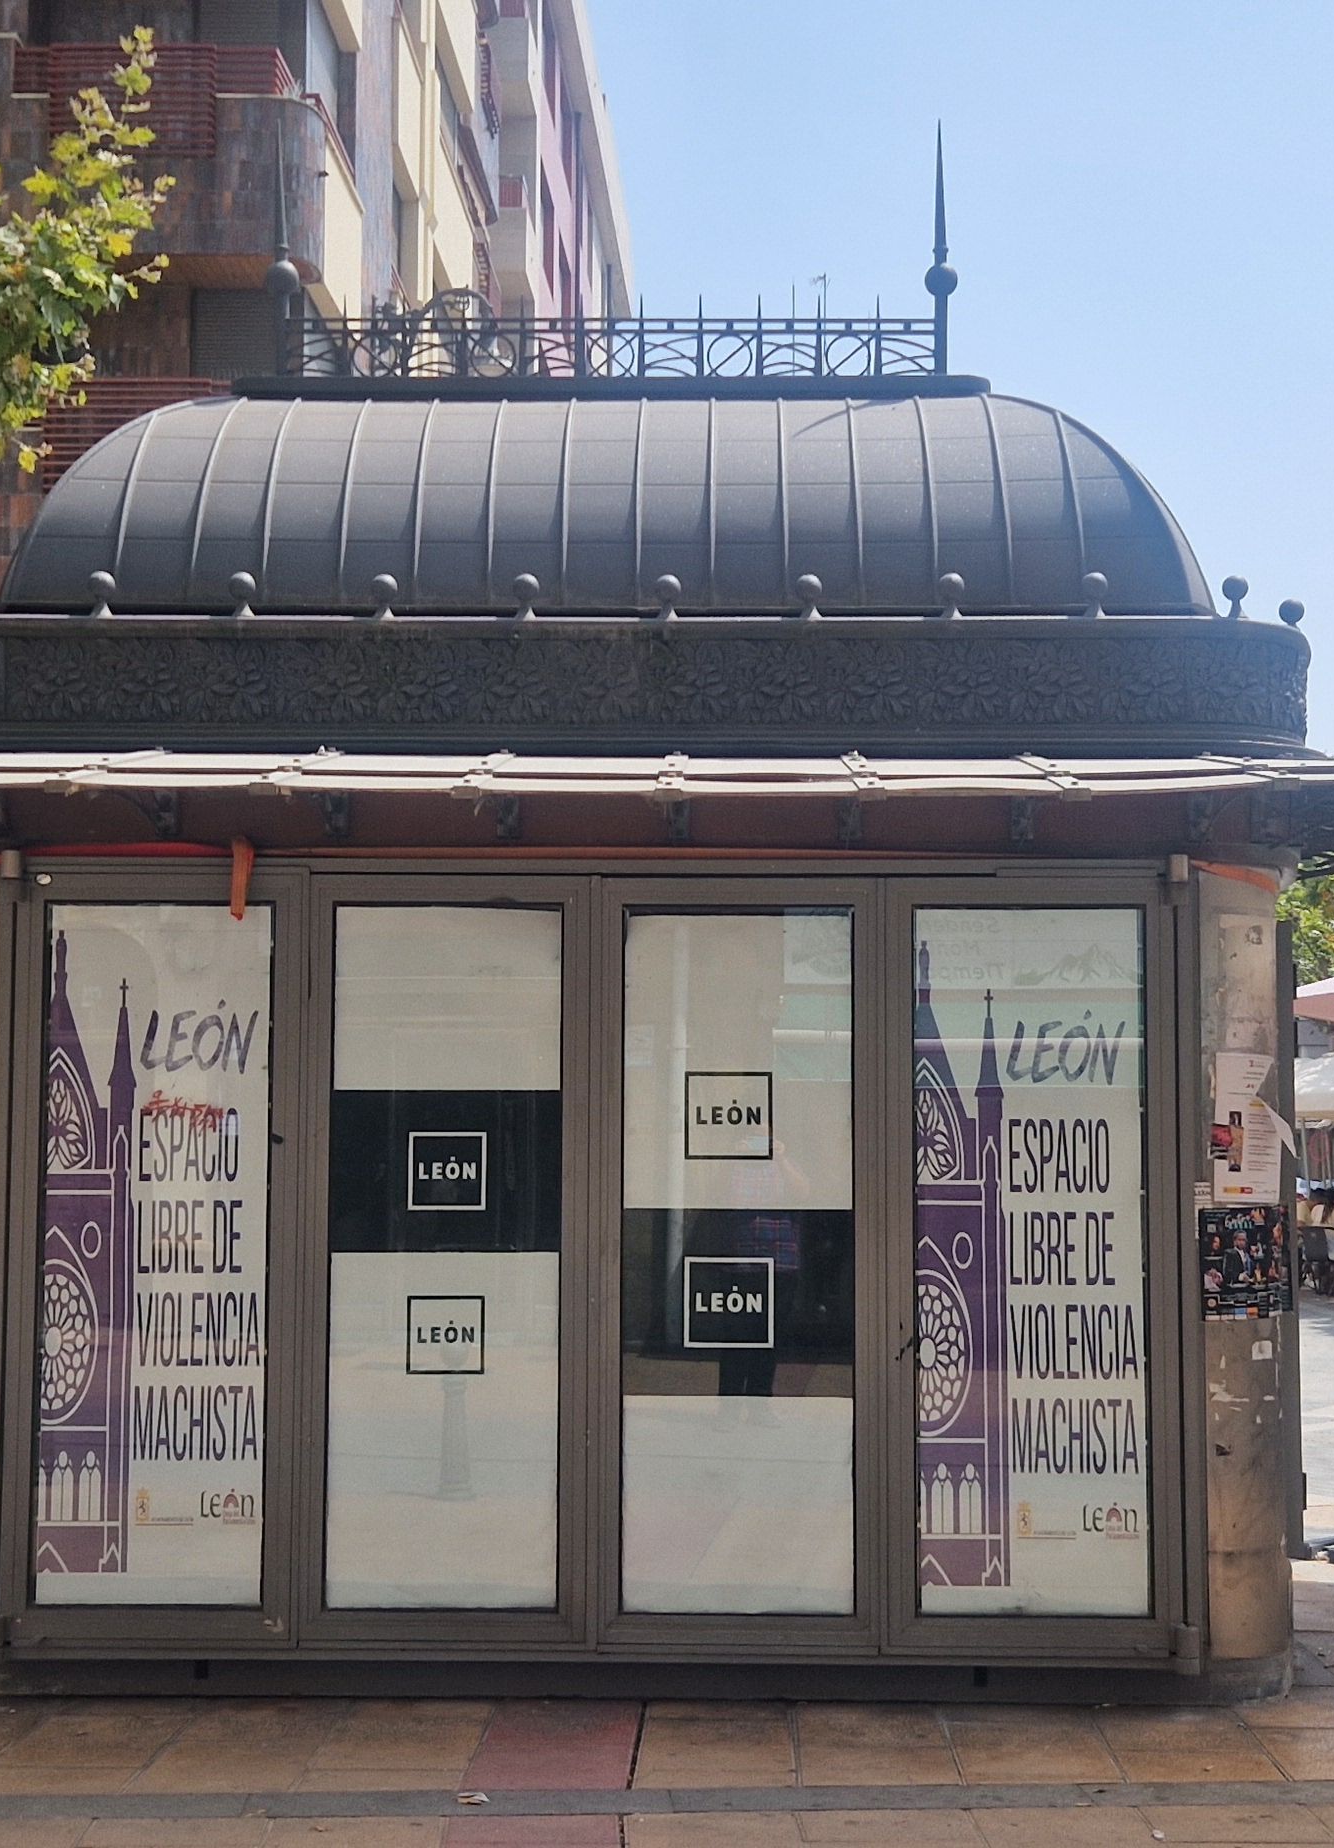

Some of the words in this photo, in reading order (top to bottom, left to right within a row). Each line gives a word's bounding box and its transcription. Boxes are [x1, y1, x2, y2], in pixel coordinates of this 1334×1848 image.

[140, 999, 259, 1075] LEÓN
[1006, 1009, 1126, 1086] LEÓN
[139, 1107, 240, 1182] ESPACIO
[695, 1099, 762, 1125] LEÓN
[418, 1156, 477, 1180] LEÓN
[1008, 1118, 1110, 1193] ESPACIO
[137, 1200, 205, 1274] LIBRE
[212, 1200, 243, 1274] DE
[1009, 1211, 1077, 1286] LIBRE
[1085, 1211, 1116, 1286] DE
[137, 1292, 260, 1367] VIOLENCIA
[416, 1320, 476, 1344] LEÓN
[695, 1285, 763, 1313] LEÓN
[1010, 1304, 1139, 1380] VIOLENCIA
[133, 1384, 258, 1461] MACHISTA
[1011, 1398, 1140, 1475] MACHISTA
